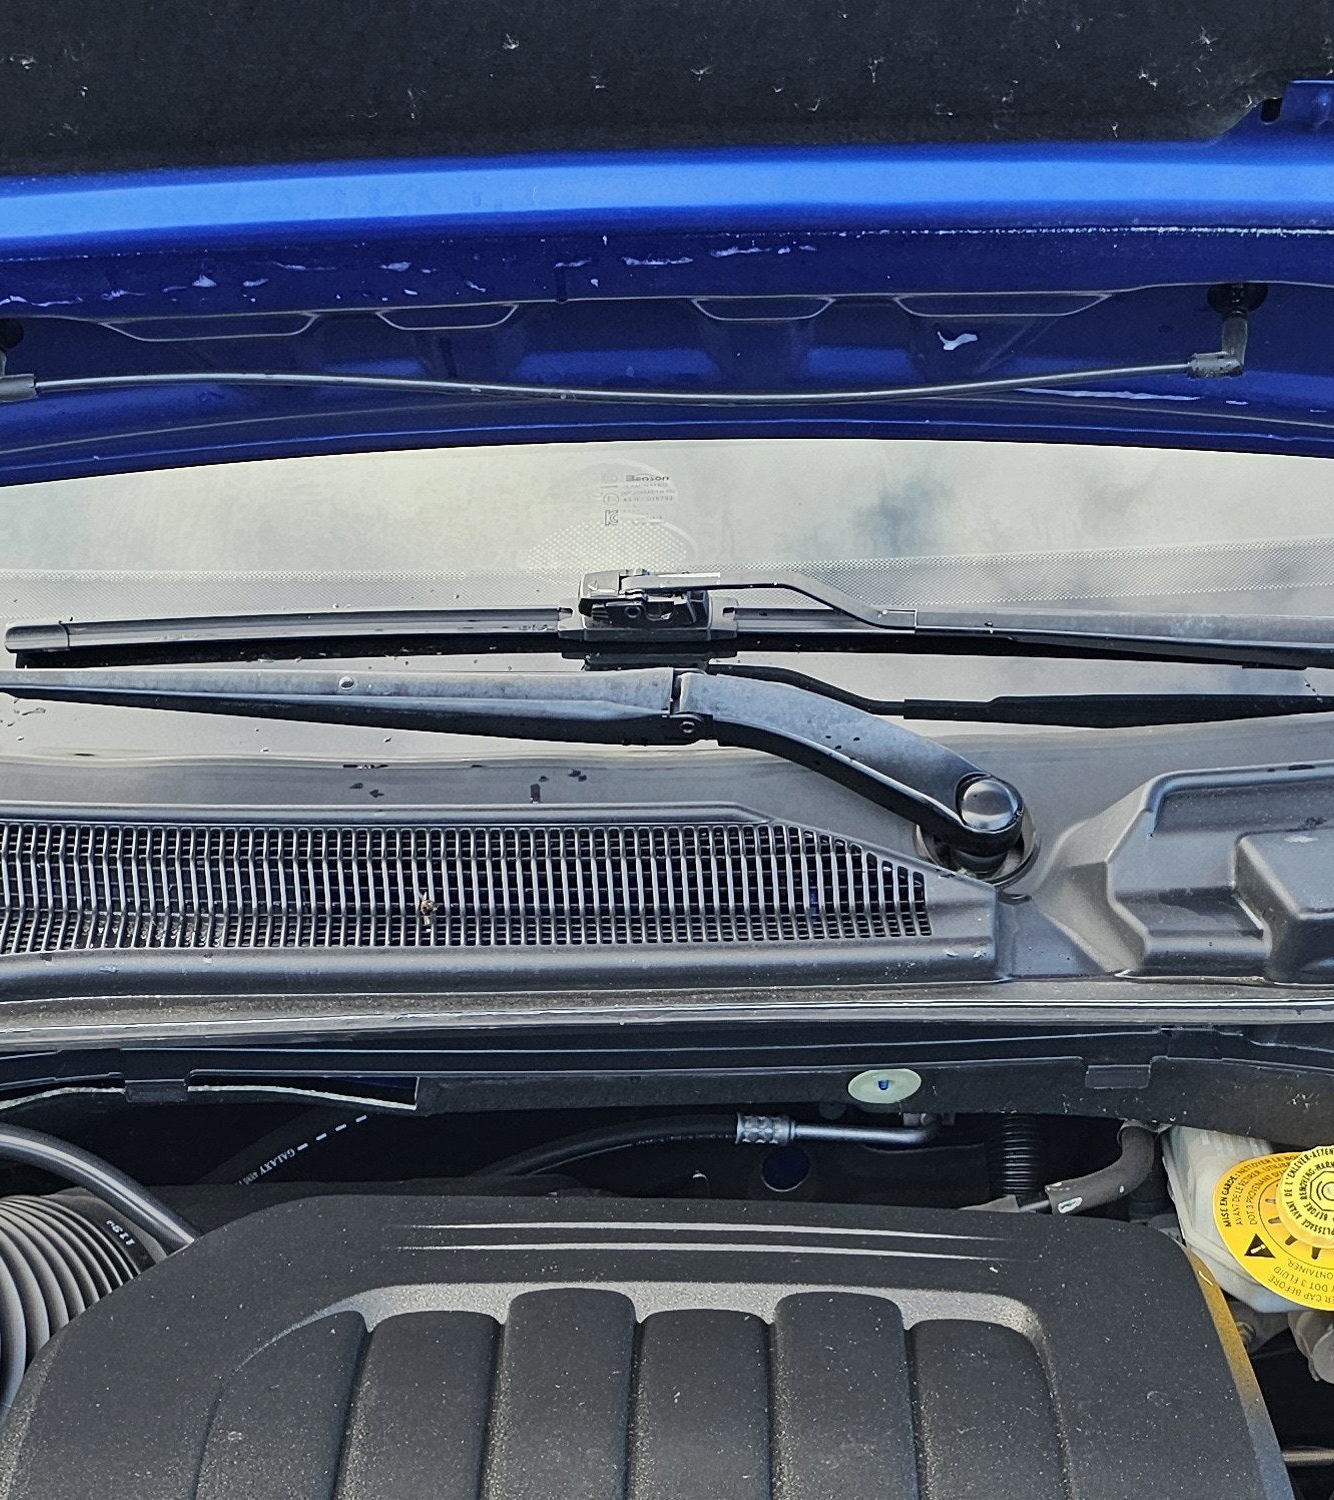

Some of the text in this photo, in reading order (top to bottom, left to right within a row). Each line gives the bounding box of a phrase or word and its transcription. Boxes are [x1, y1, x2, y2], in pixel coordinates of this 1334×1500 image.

[260, 1148, 296, 1175] GALAXY
[1220, 1197, 1227, 1205] EN
[1220, 1208, 1232, 1227] MISE
[1247, 1211, 1258, 1225] DOT
[1286, 1201, 1302, 1219] AVANT
[1303, 1202, 1328, 1221] BEFORE
[1273, 1266, 1298, 1283] FLUID
[1300, 1279, 1306, 1287] 3
[1267, 1274, 1302, 1297] BEFORE
[1309, 1282, 1328, 1293] DOT
[1303, 1291, 1322, 1302] CAP
